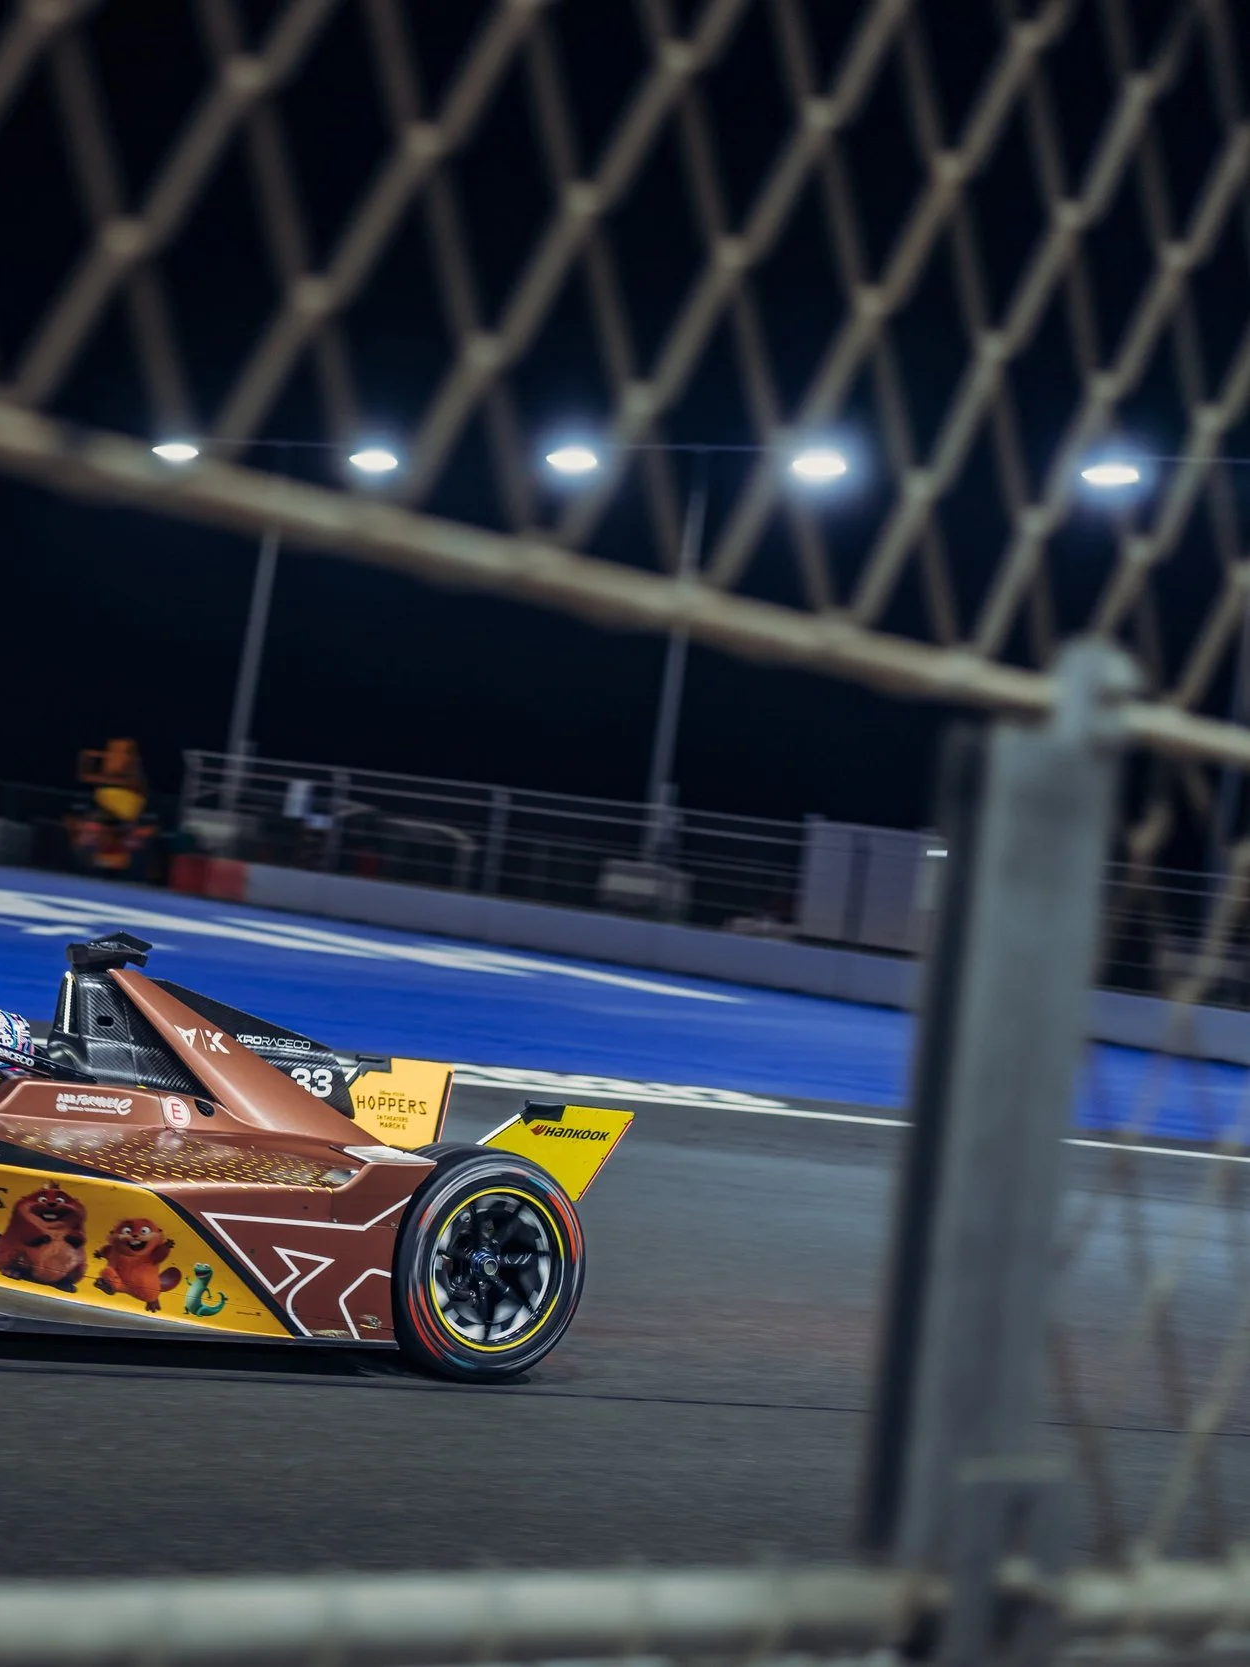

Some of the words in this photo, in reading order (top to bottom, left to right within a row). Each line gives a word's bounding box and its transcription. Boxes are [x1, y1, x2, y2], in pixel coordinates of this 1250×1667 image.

[290, 1068, 333, 1098] 33
[171, 1103, 184, 1120] E
[356, 1095, 427, 1115] HOPPERS
